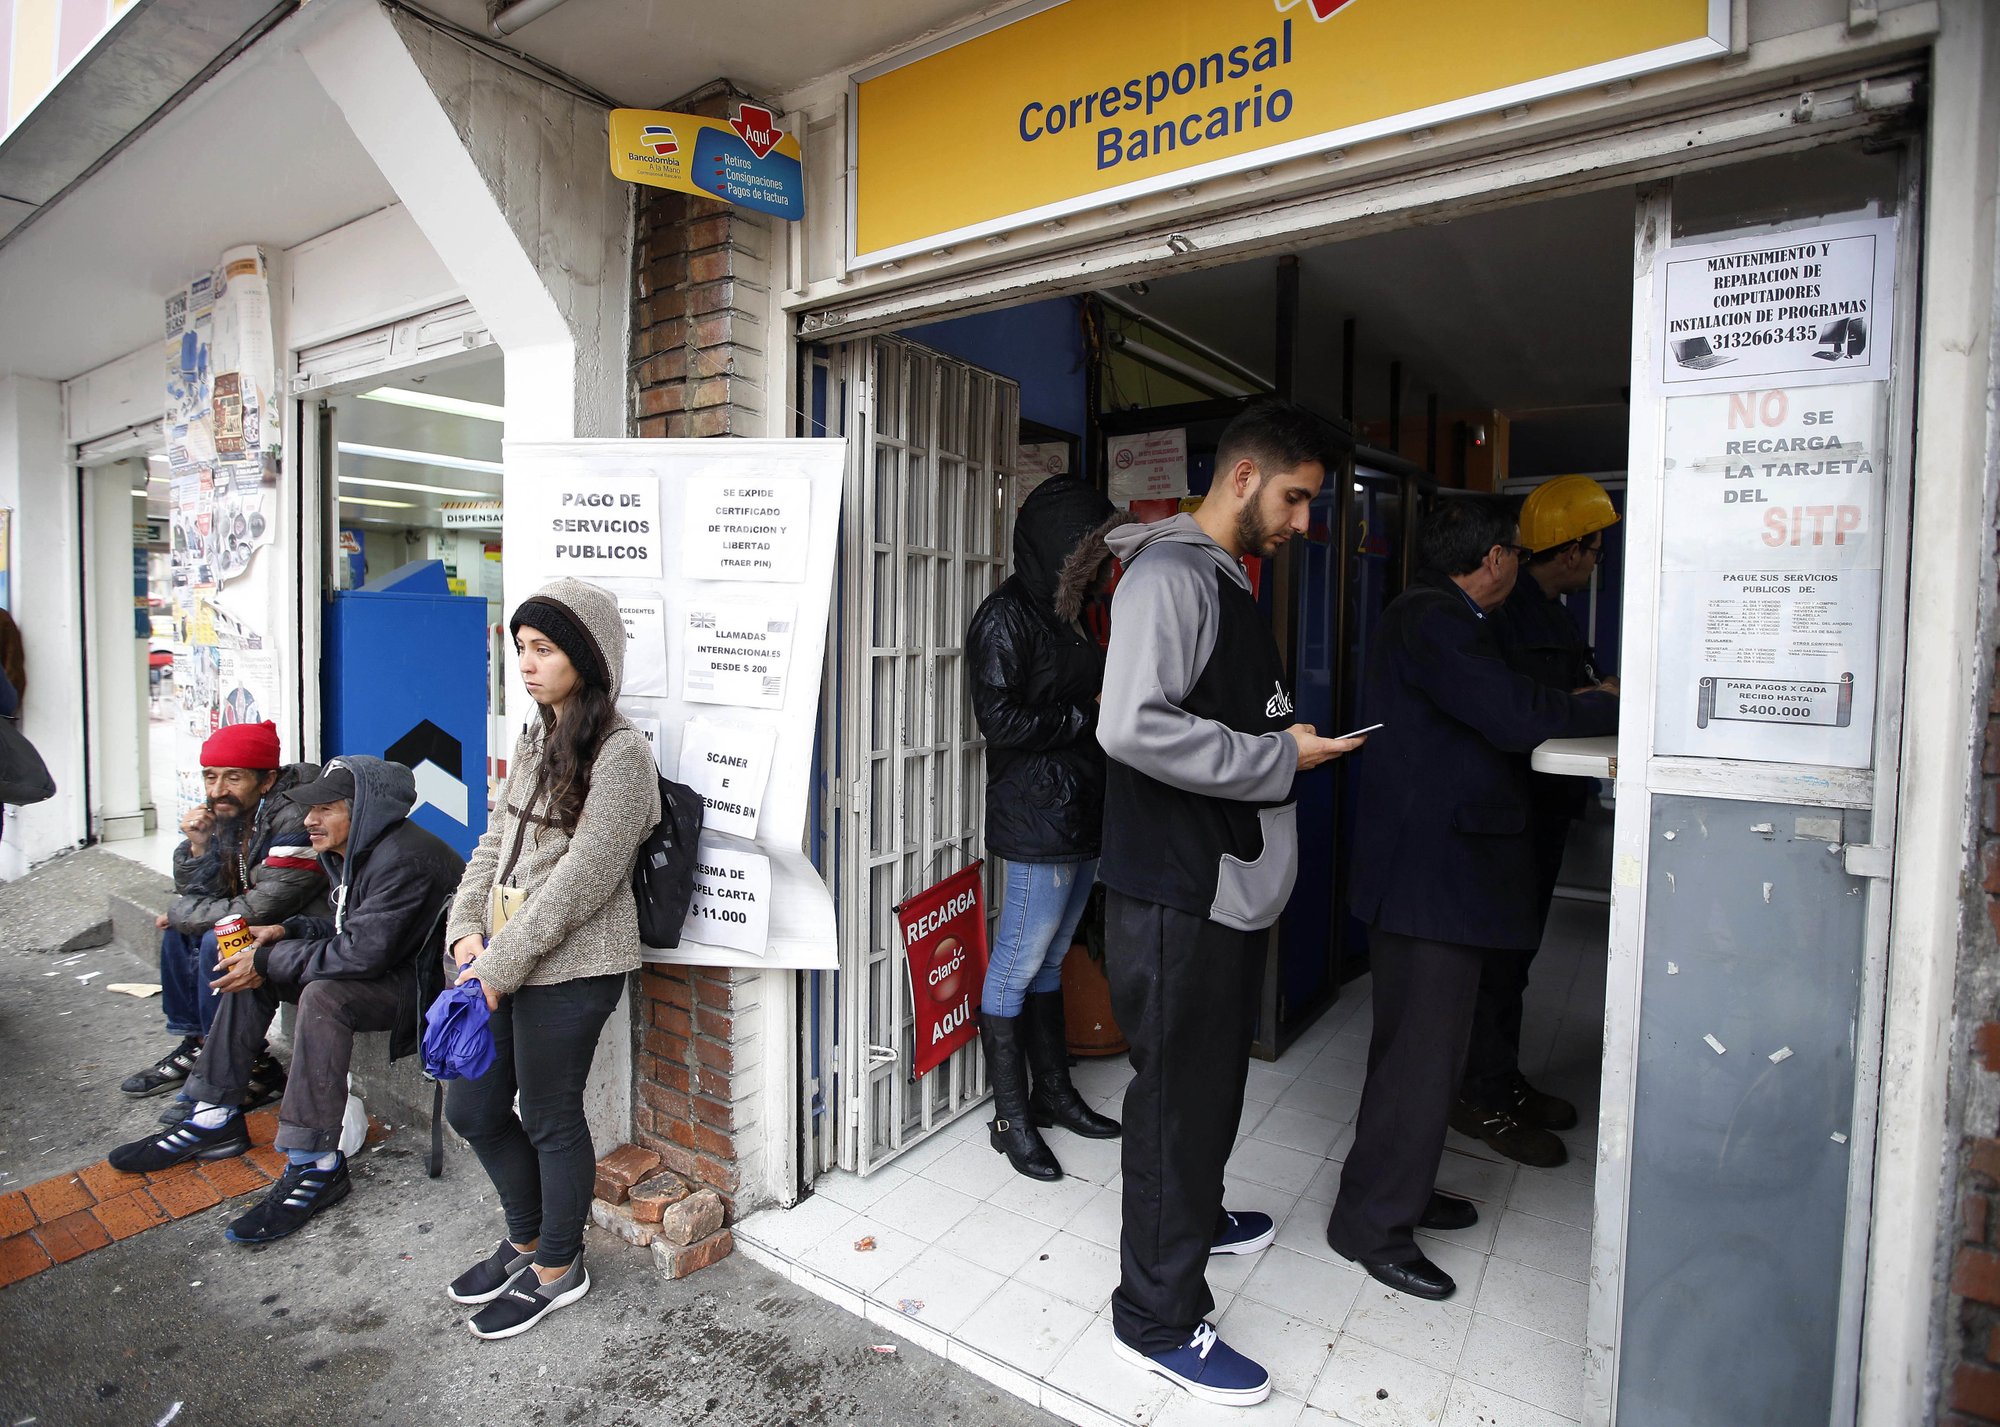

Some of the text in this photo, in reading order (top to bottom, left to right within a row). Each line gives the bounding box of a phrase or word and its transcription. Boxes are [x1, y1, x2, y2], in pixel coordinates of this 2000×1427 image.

[1019, 19, 1292, 142] Corresponsal
[746, 124, 770, 147] Aquí
[1097, 84, 1293, 171] Bancario
[628, 153, 680, 166] Bancolombia
[724, 153, 752, 170] Retiros
[664, 165, 681, 174] Mano
[726, 168, 783, 190] Consignaciones
[727, 182, 789, 205] Pagos de factura
[1707, 243, 1830, 272] MANTENIMIENTO Y
[1714, 264, 1821, 289] REPARACION DE
[1714, 284, 1821, 308] COMPUTADORES
[1670, 299, 1866, 332] INSTALACION DE PROGRAMAS
[1713, 325, 1817, 349] 3132663435
[1728, 389, 1833, 429] NO SE
[1726, 436, 1842, 454] RECARGA
[1725, 460, 1872, 479] LA TARJETA
[562, 493, 641, 508] PAGO DE
[723, 489, 774, 497] SE EXPIDE
[1724, 489, 1768, 503] DEL
[715, 507, 781, 516] CERTIFICADO
[552, 519, 649, 533] SERVICIOS
[708, 525, 720, 533] DE
[723, 526, 777, 534] TRADICION
[1761, 505, 1861, 547] SITP
[556, 545, 648, 559] PUBLICOS
[723, 541, 770, 550] LIBERTAD
[720, 559, 772, 568] (TRAER PIN)
[1723, 574, 1757, 582] PAGUE
[715, 631, 766, 641] LLAMADAS
[697, 646, 781, 658] INTERNACIONALES
[711, 662, 767, 673] DESDE $ 200
[1755, 684, 1787, 692] PAGOS
[1777, 694, 1812, 702] HASTA:
[1739, 704, 1810, 717] $400.000
[707, 752, 748, 768] SCANER
[722, 779, 730, 788] E
[703, 797, 741, 814] ESIONES
[694, 862, 745, 880] RESMA DE
[692, 884, 755, 902] APEL CARTA
[692, 904, 746, 924] $ 11.000
[907, 888, 976, 945] RECARGA
[928, 951, 963, 985] Claro
[932, 994, 970, 1045] AQUÍ
